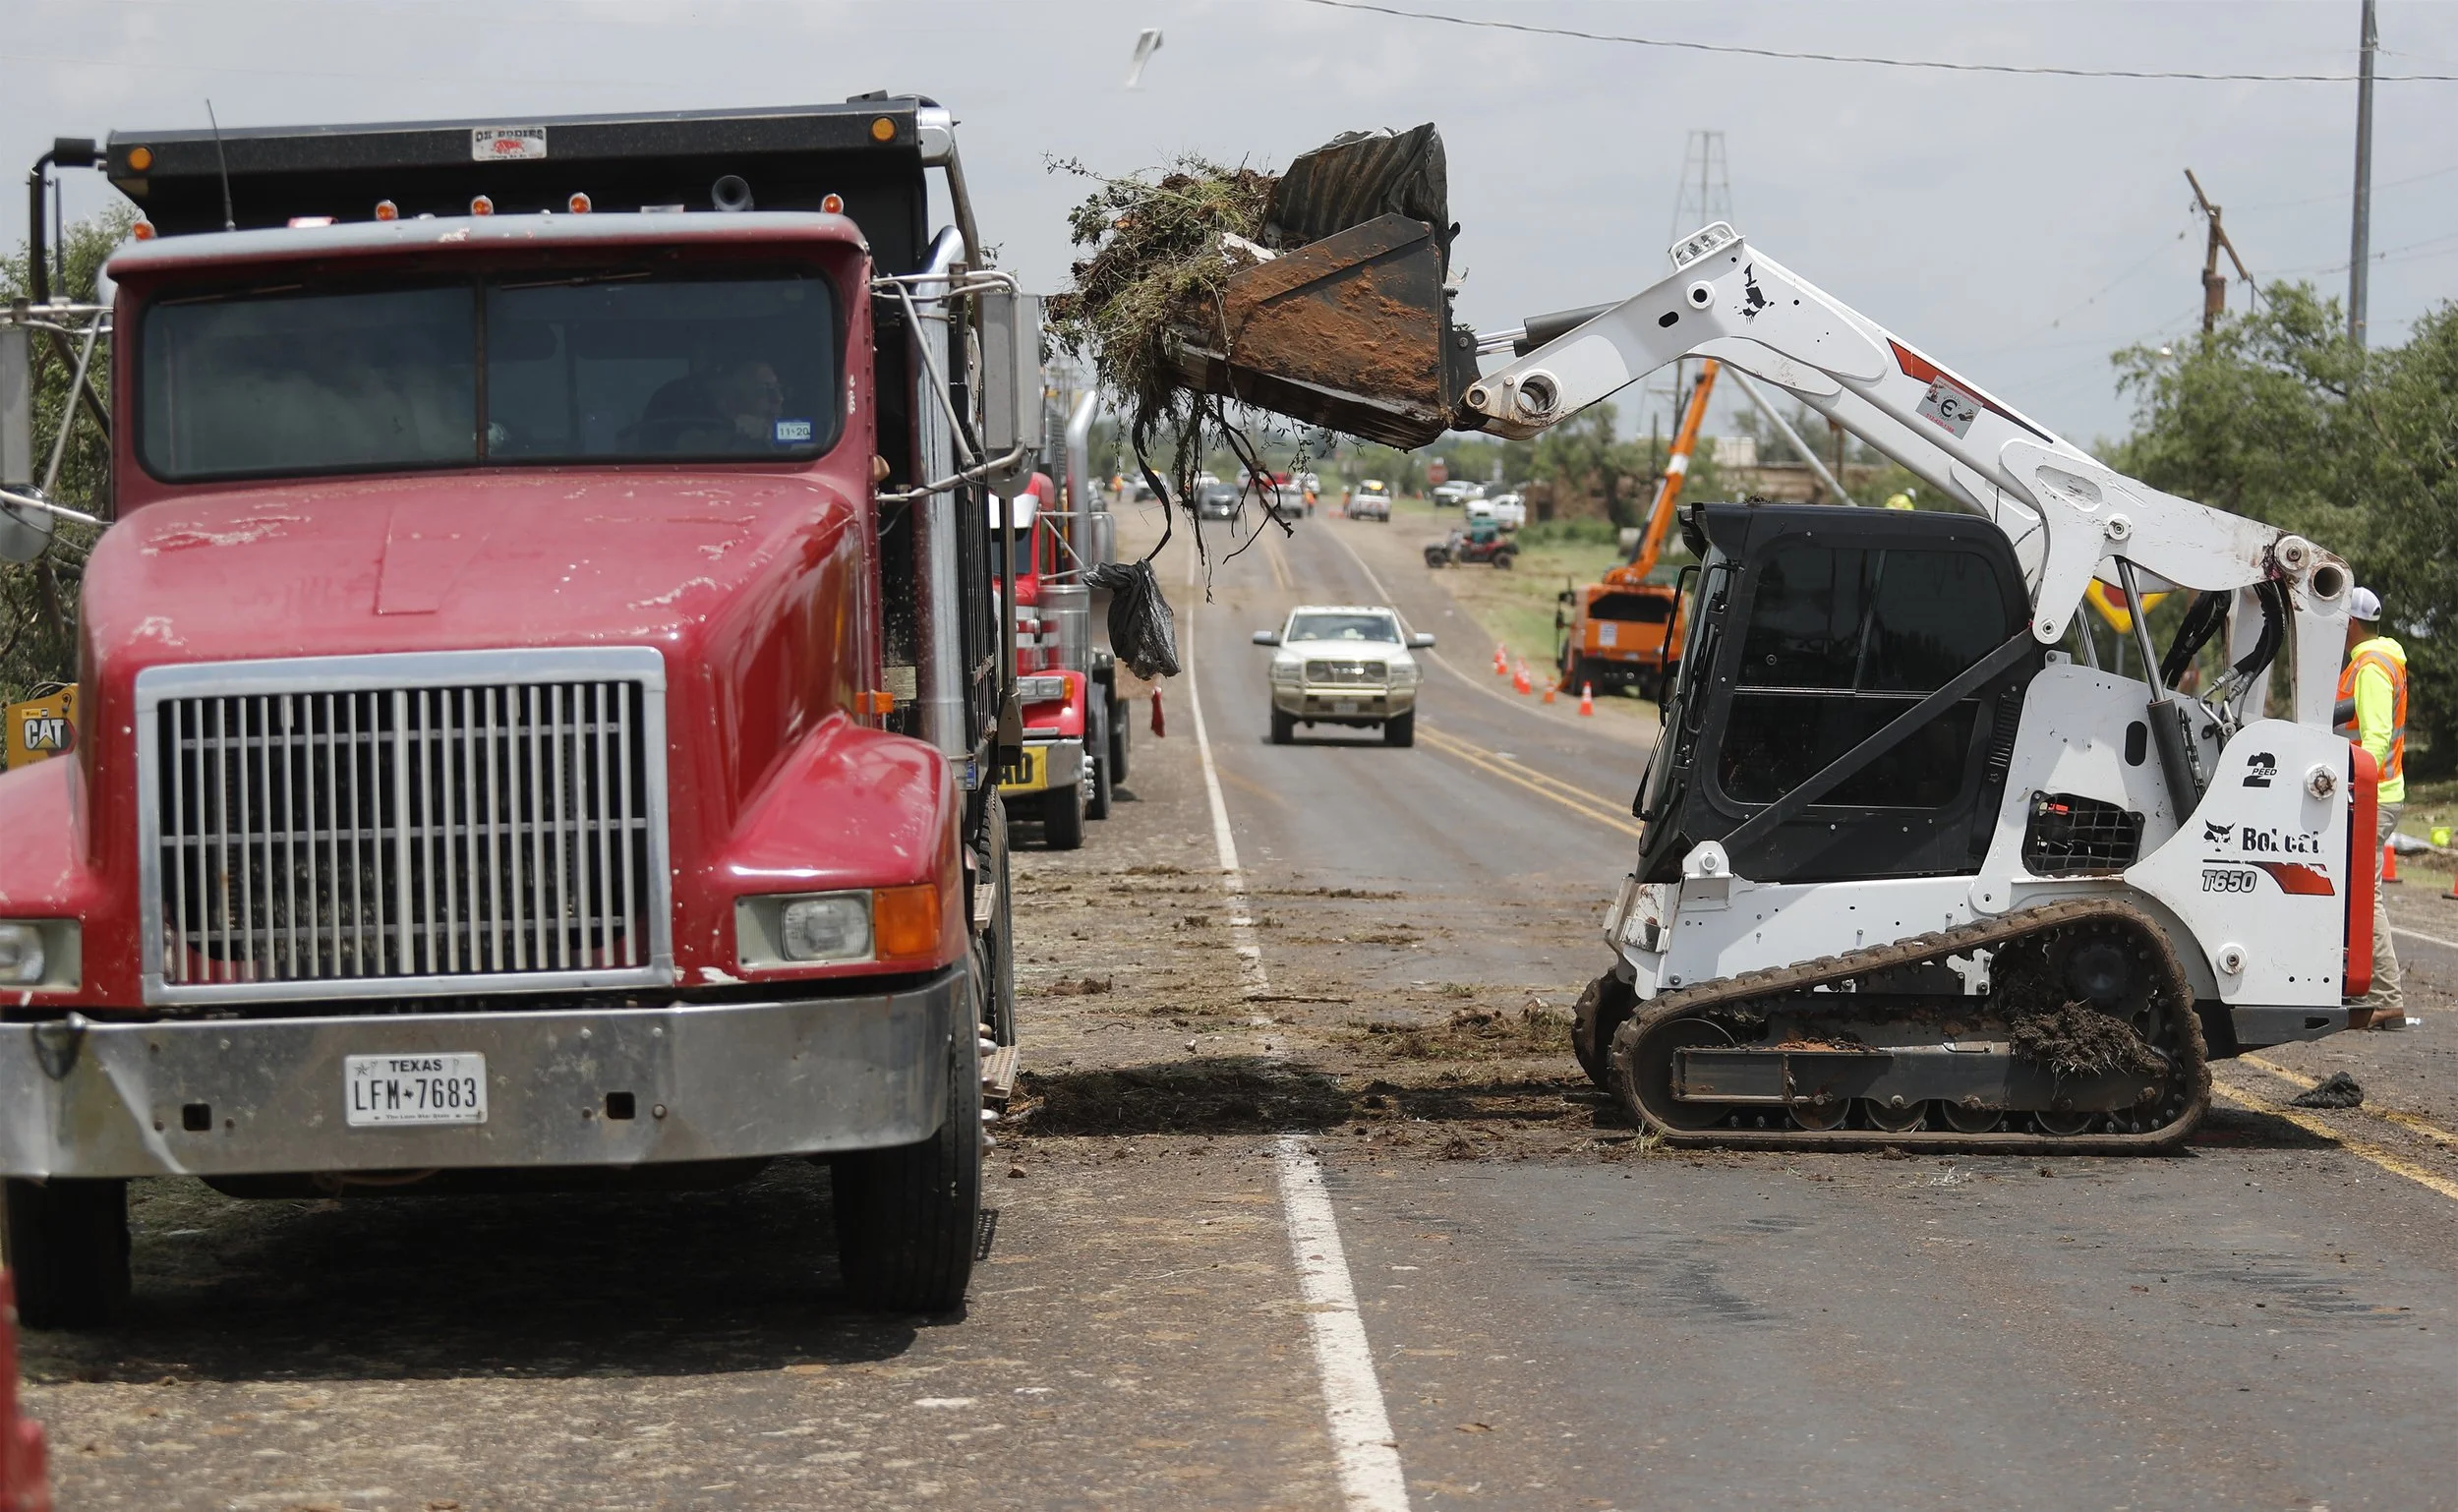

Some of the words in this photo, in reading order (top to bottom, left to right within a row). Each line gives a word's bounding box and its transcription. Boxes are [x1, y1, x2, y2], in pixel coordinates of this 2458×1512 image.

[25, 719, 64, 749] CAT
[2202, 869, 2257, 893] T650
[389, 1059, 442, 1073] TEXAS
